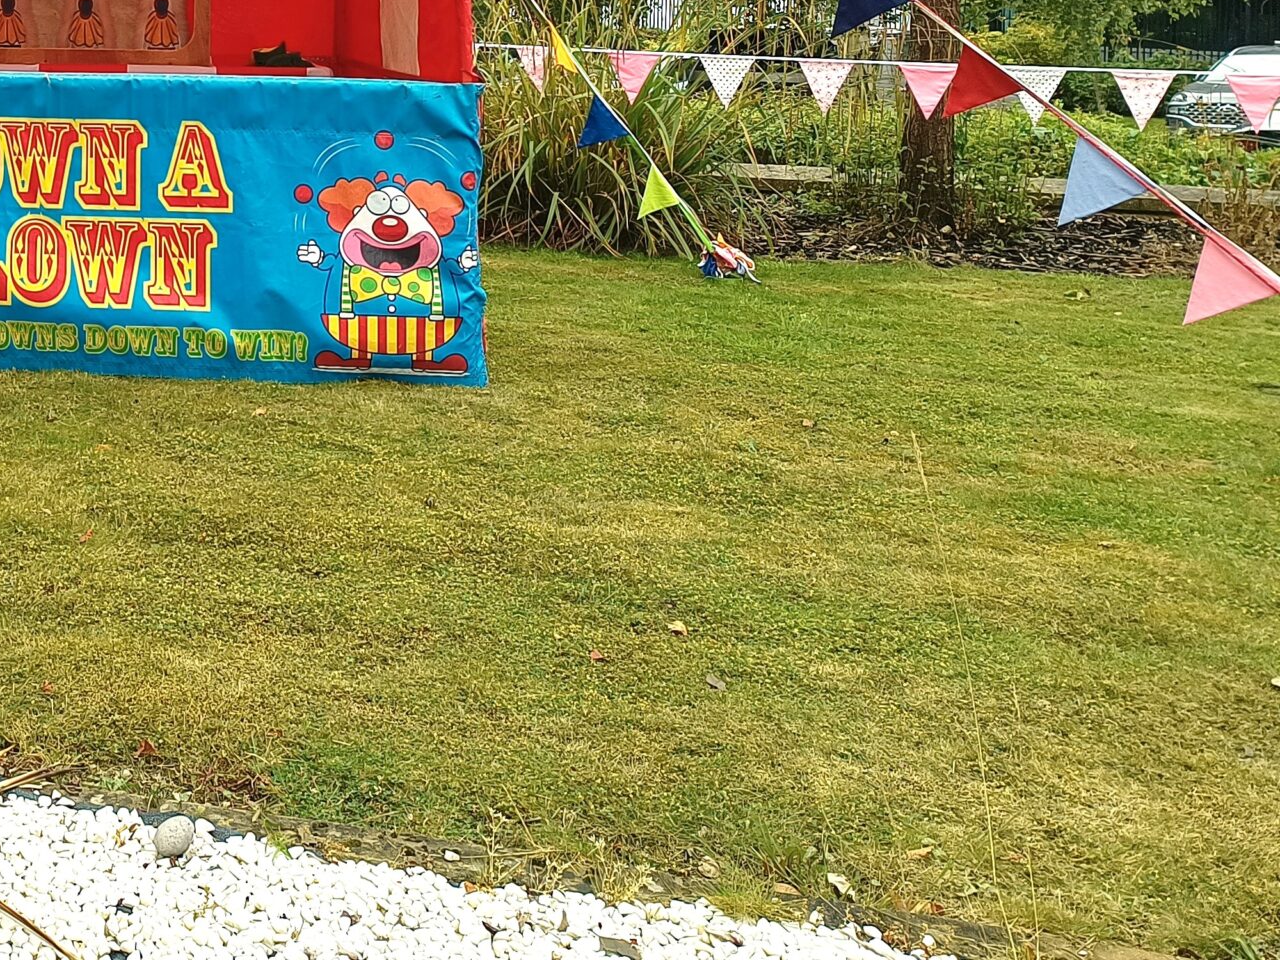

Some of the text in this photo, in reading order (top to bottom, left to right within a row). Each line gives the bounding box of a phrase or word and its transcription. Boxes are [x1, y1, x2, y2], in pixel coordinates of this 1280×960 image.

[158, 120, 234, 213] A
[83, 323, 180, 358] DOWN
[182, 327, 227, 360] TO
[230, 329, 309, 363] WIN!
